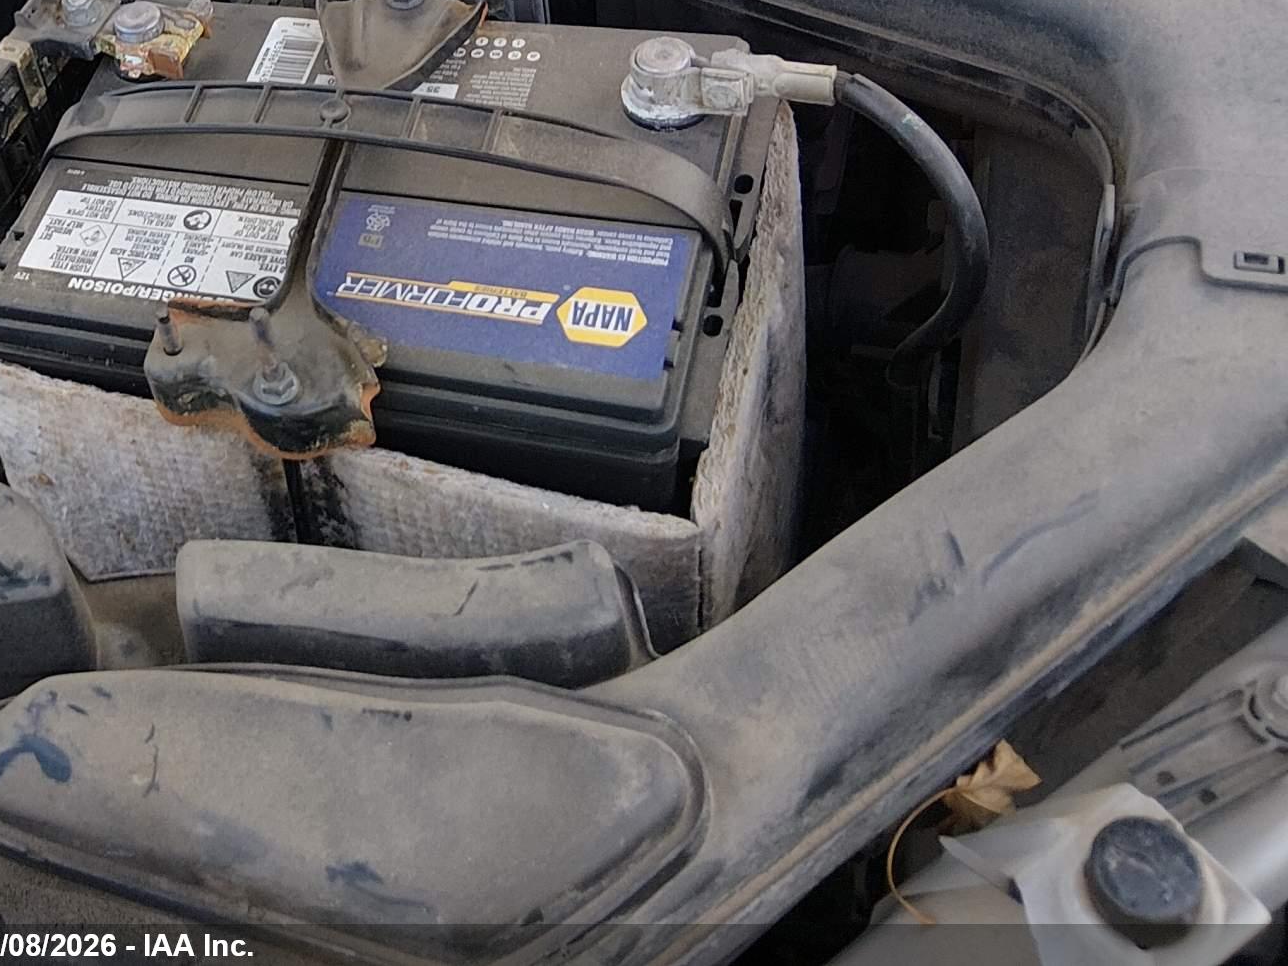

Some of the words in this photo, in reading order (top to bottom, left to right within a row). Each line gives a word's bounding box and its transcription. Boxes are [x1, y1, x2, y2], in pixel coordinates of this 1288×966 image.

[336, 275, 551, 317] PROFORMER
[474, 284, 529, 300] BATTERIES
[571, 300, 634, 332] NAPA
